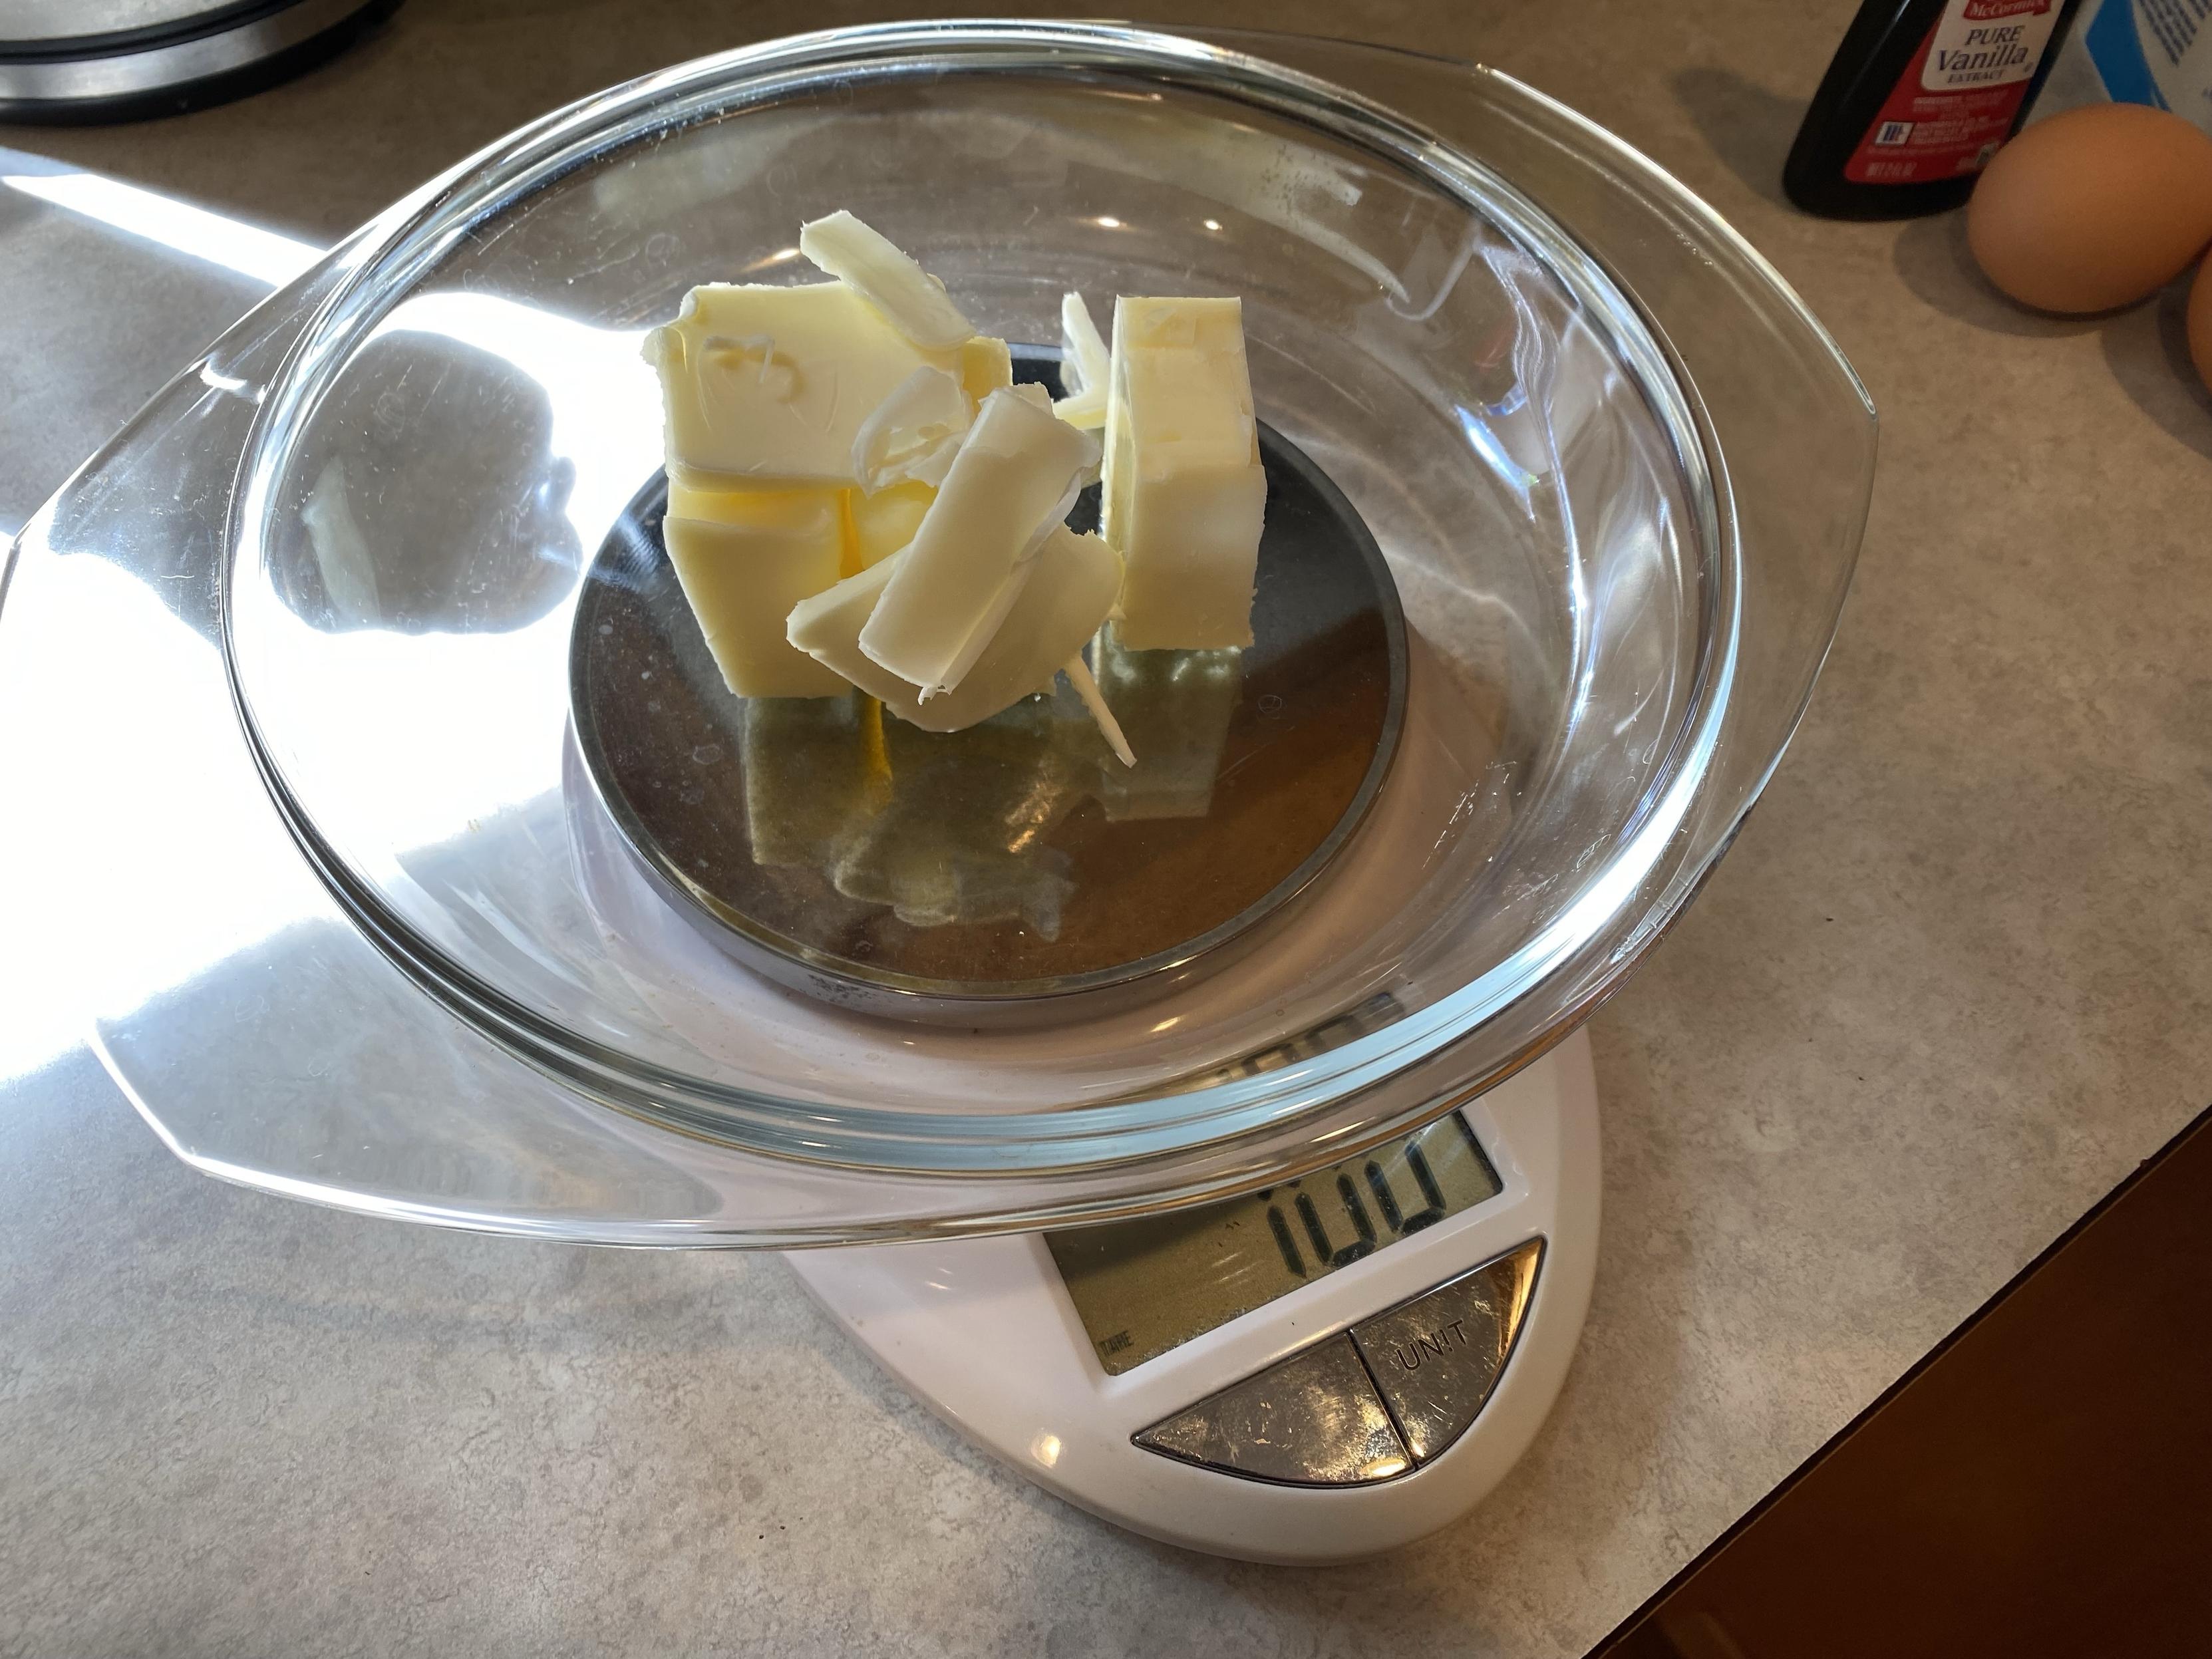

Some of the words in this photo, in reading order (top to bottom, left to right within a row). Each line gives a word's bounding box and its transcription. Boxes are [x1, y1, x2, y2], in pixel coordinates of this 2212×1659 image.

[1965, 25, 2025, 46] PURE
[1937, 44, 2028, 72] Vanilla
[1947, 69, 2005, 84] EXTRACT
[1097, 1330, 1134, 1358] TARE
